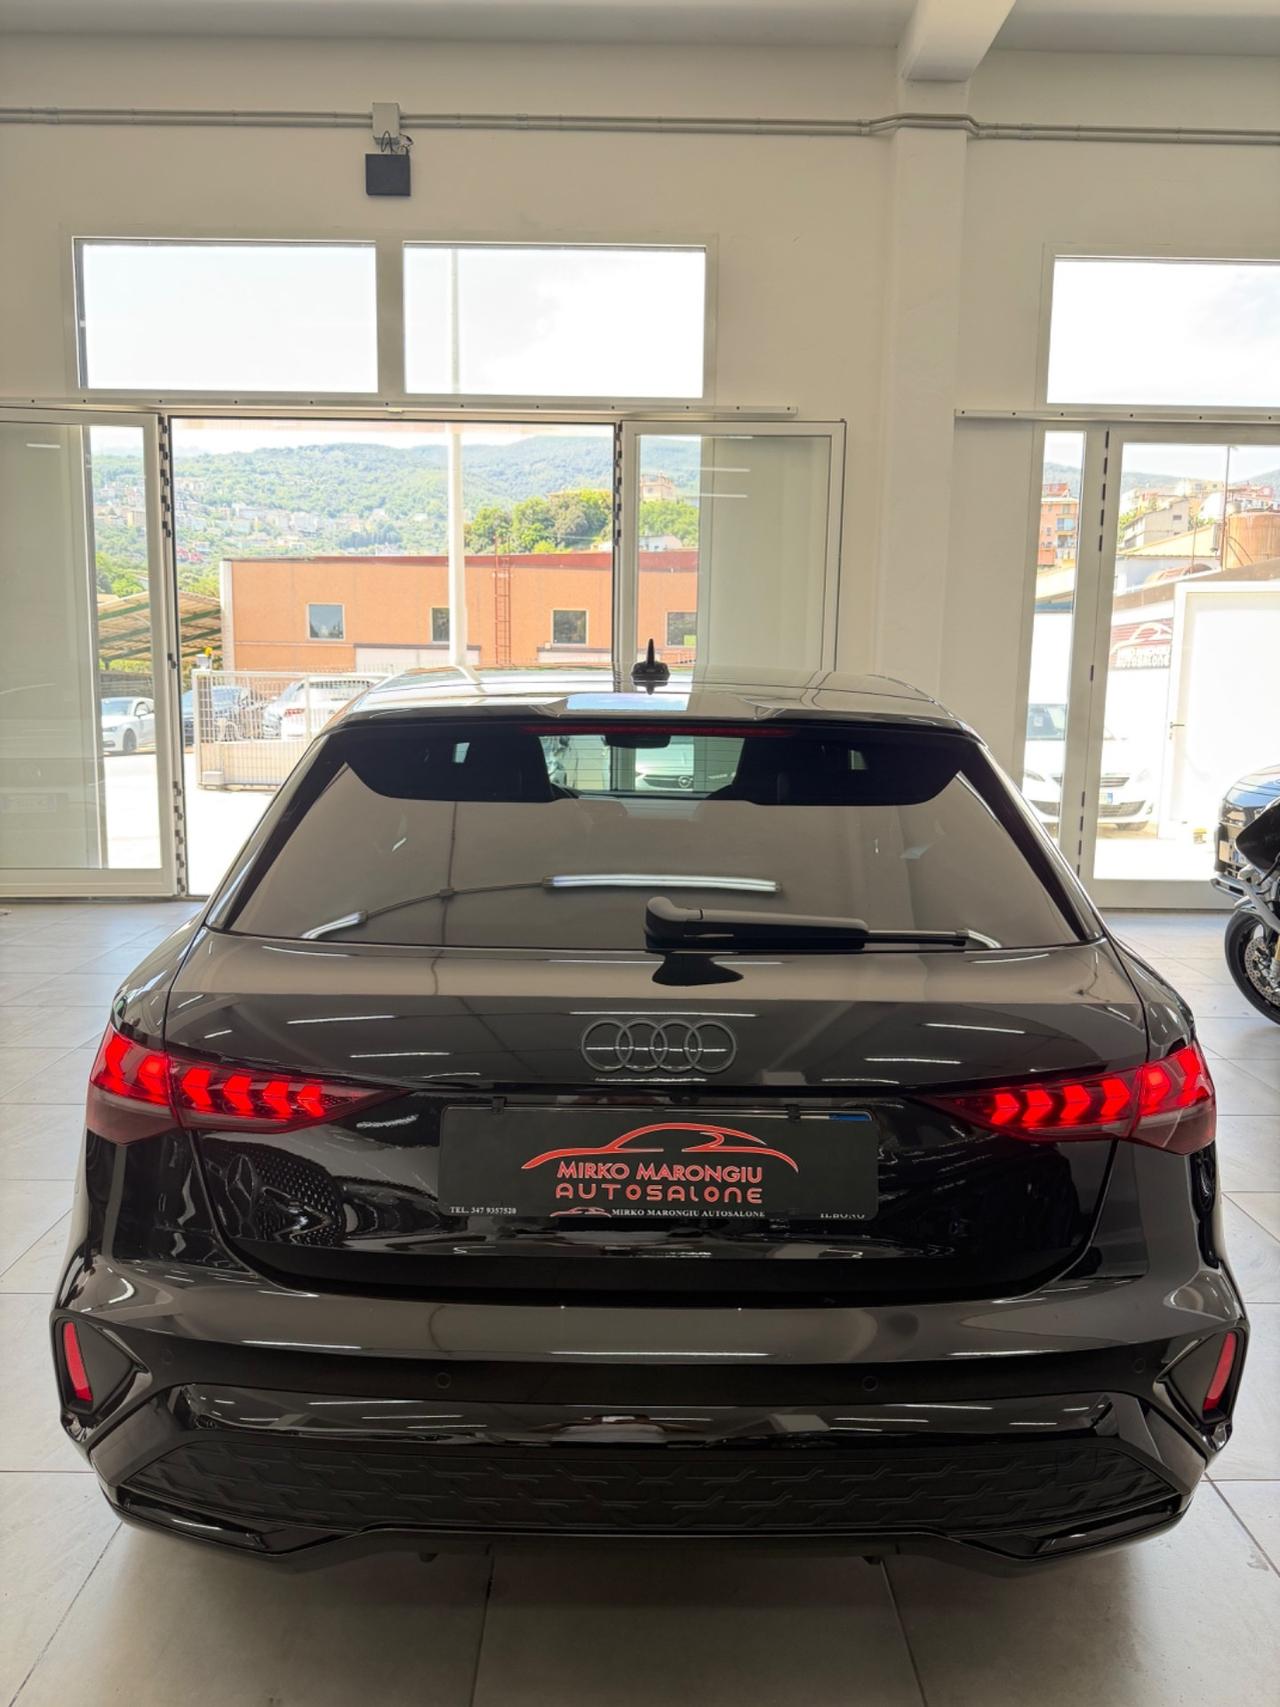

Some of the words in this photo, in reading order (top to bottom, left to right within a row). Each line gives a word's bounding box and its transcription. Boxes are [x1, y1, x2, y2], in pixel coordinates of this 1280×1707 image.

[556, 1160, 630, 1180] MIRKO
[635, 1162, 763, 1183] MARONGIU
[555, 1183, 763, 1204] AUTOSALONE
[449, 1206, 469, 1214] TEL.
[470, 1206, 484, 1214] 347
[611, 1208, 645, 1216] MIRKO
[646, 1209, 700, 1217] MARONGIU
[701, 1210, 766, 1218] AUTOSALONE
